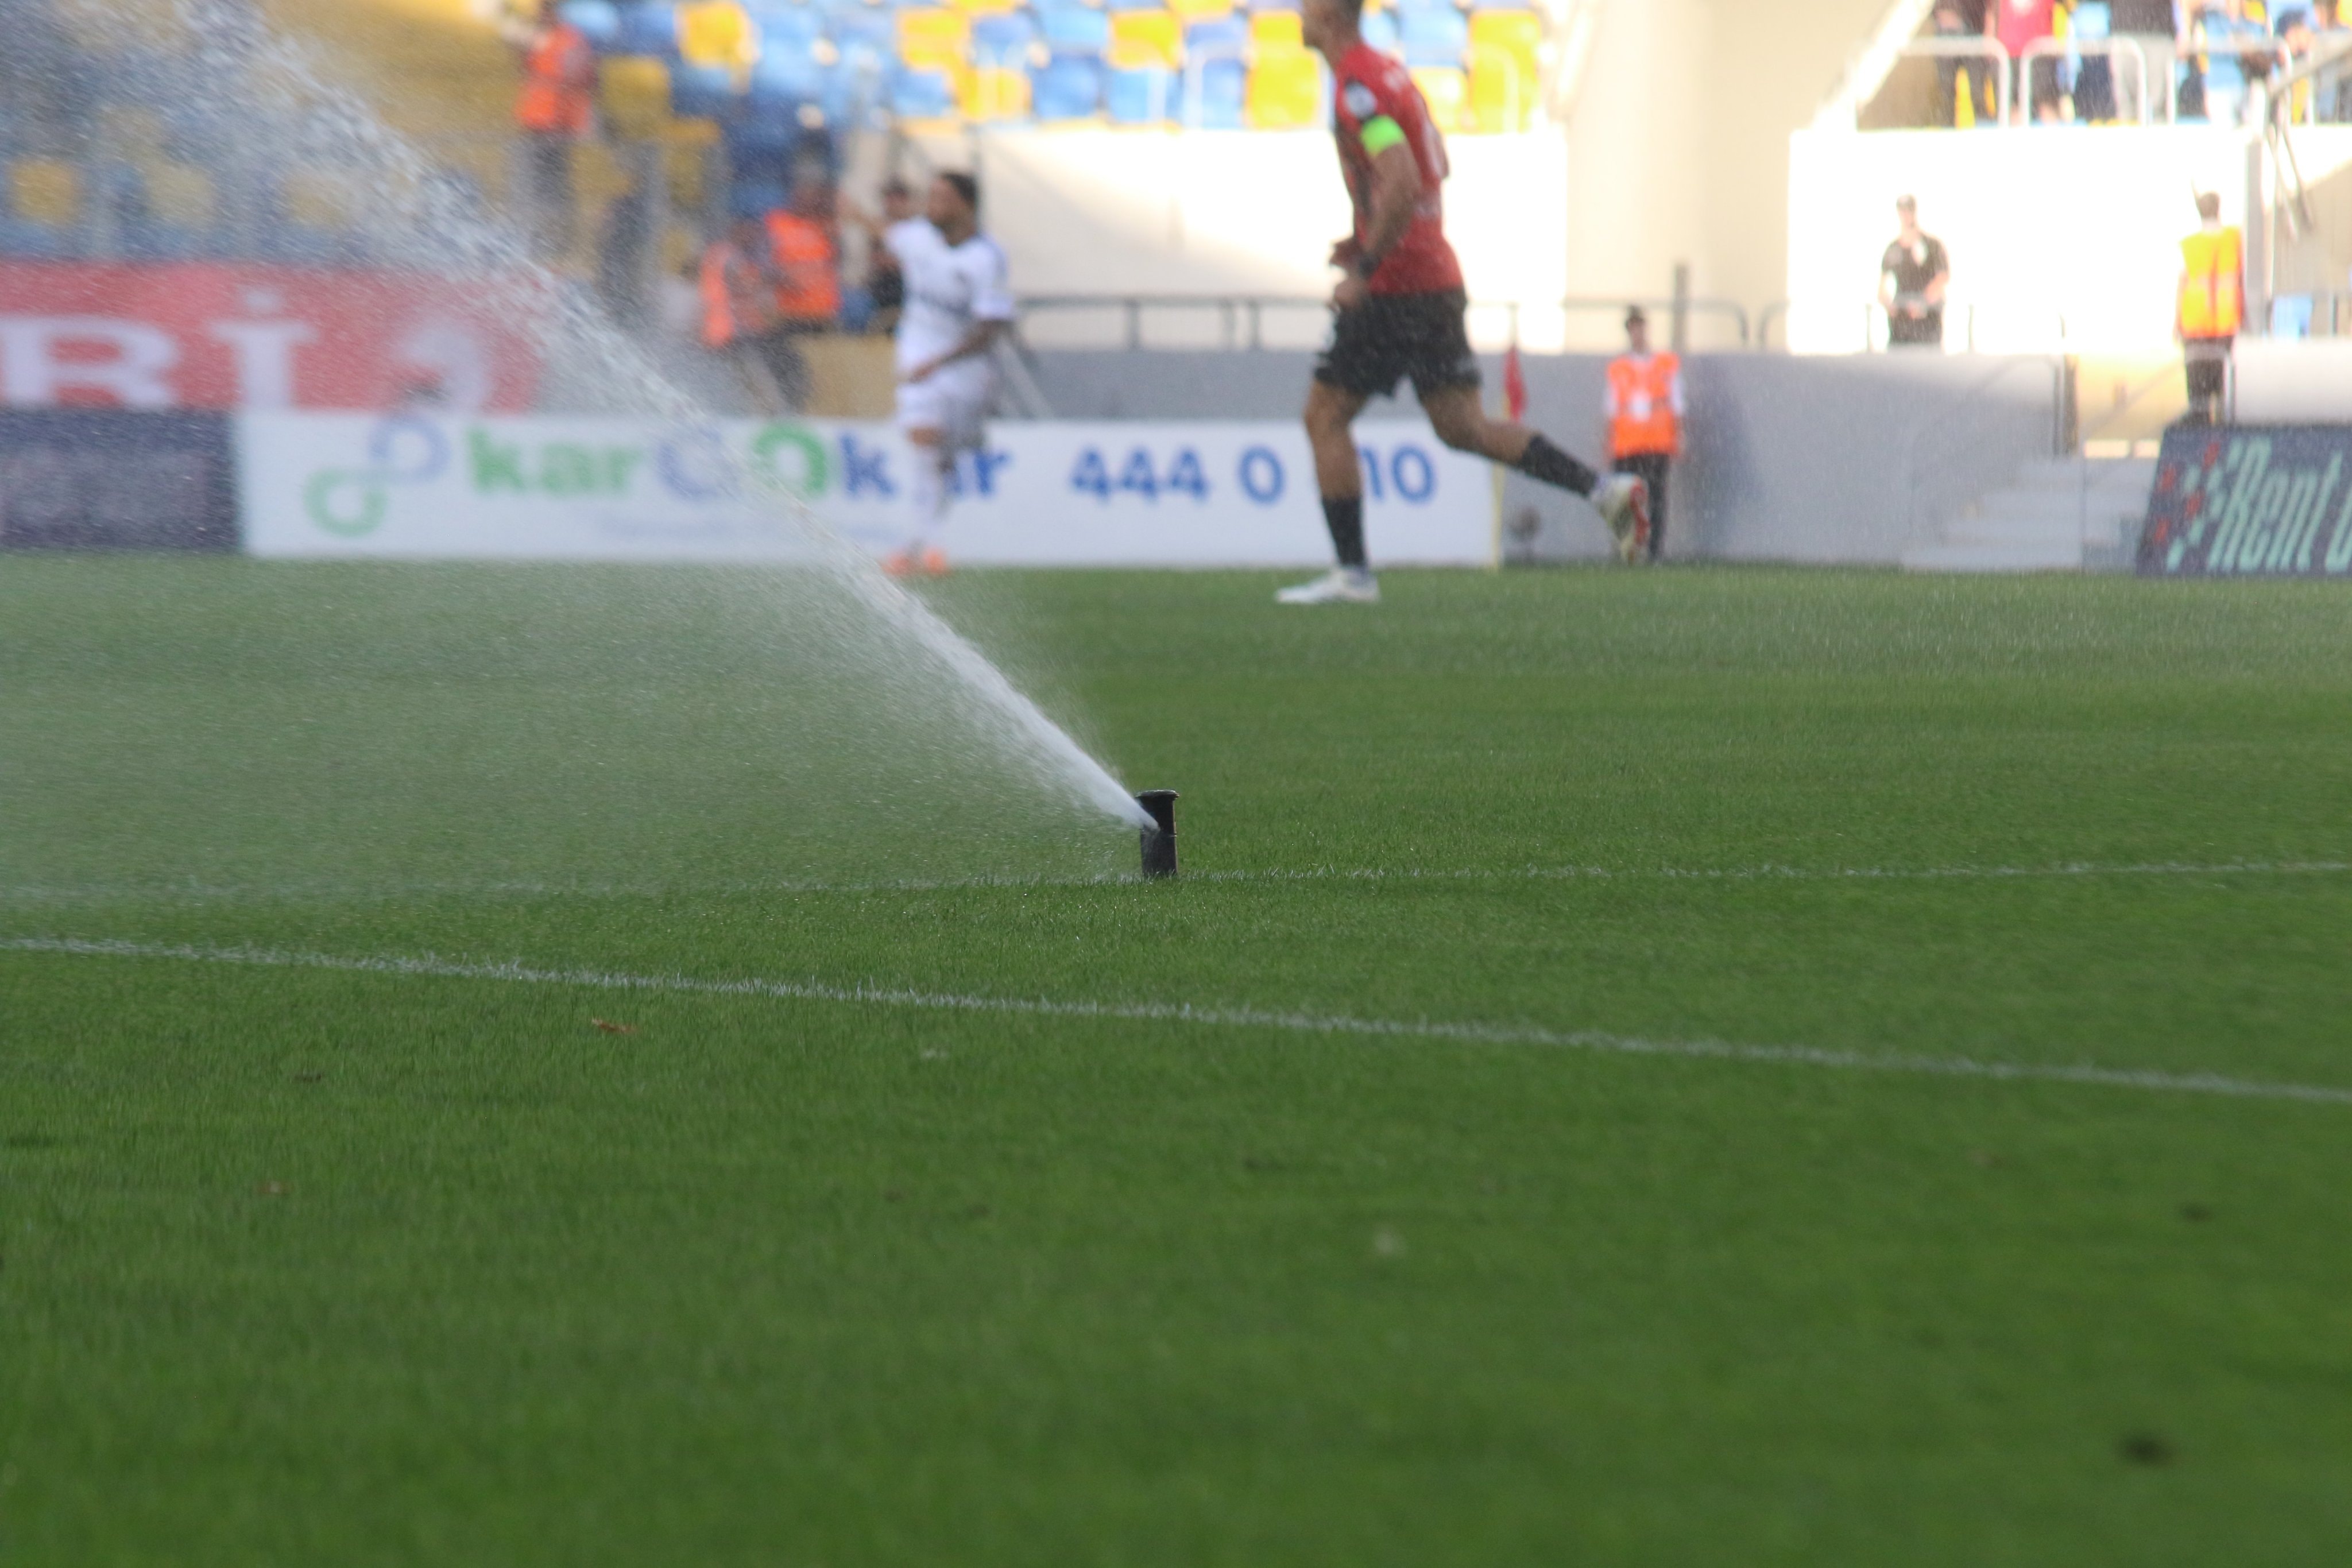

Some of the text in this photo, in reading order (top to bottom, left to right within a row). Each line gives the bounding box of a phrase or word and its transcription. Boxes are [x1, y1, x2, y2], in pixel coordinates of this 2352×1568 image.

[1069, 445, 1210, 504] 444
[1356, 443, 1437, 505] 10
[2207, 435, 2343, 572] Rent
